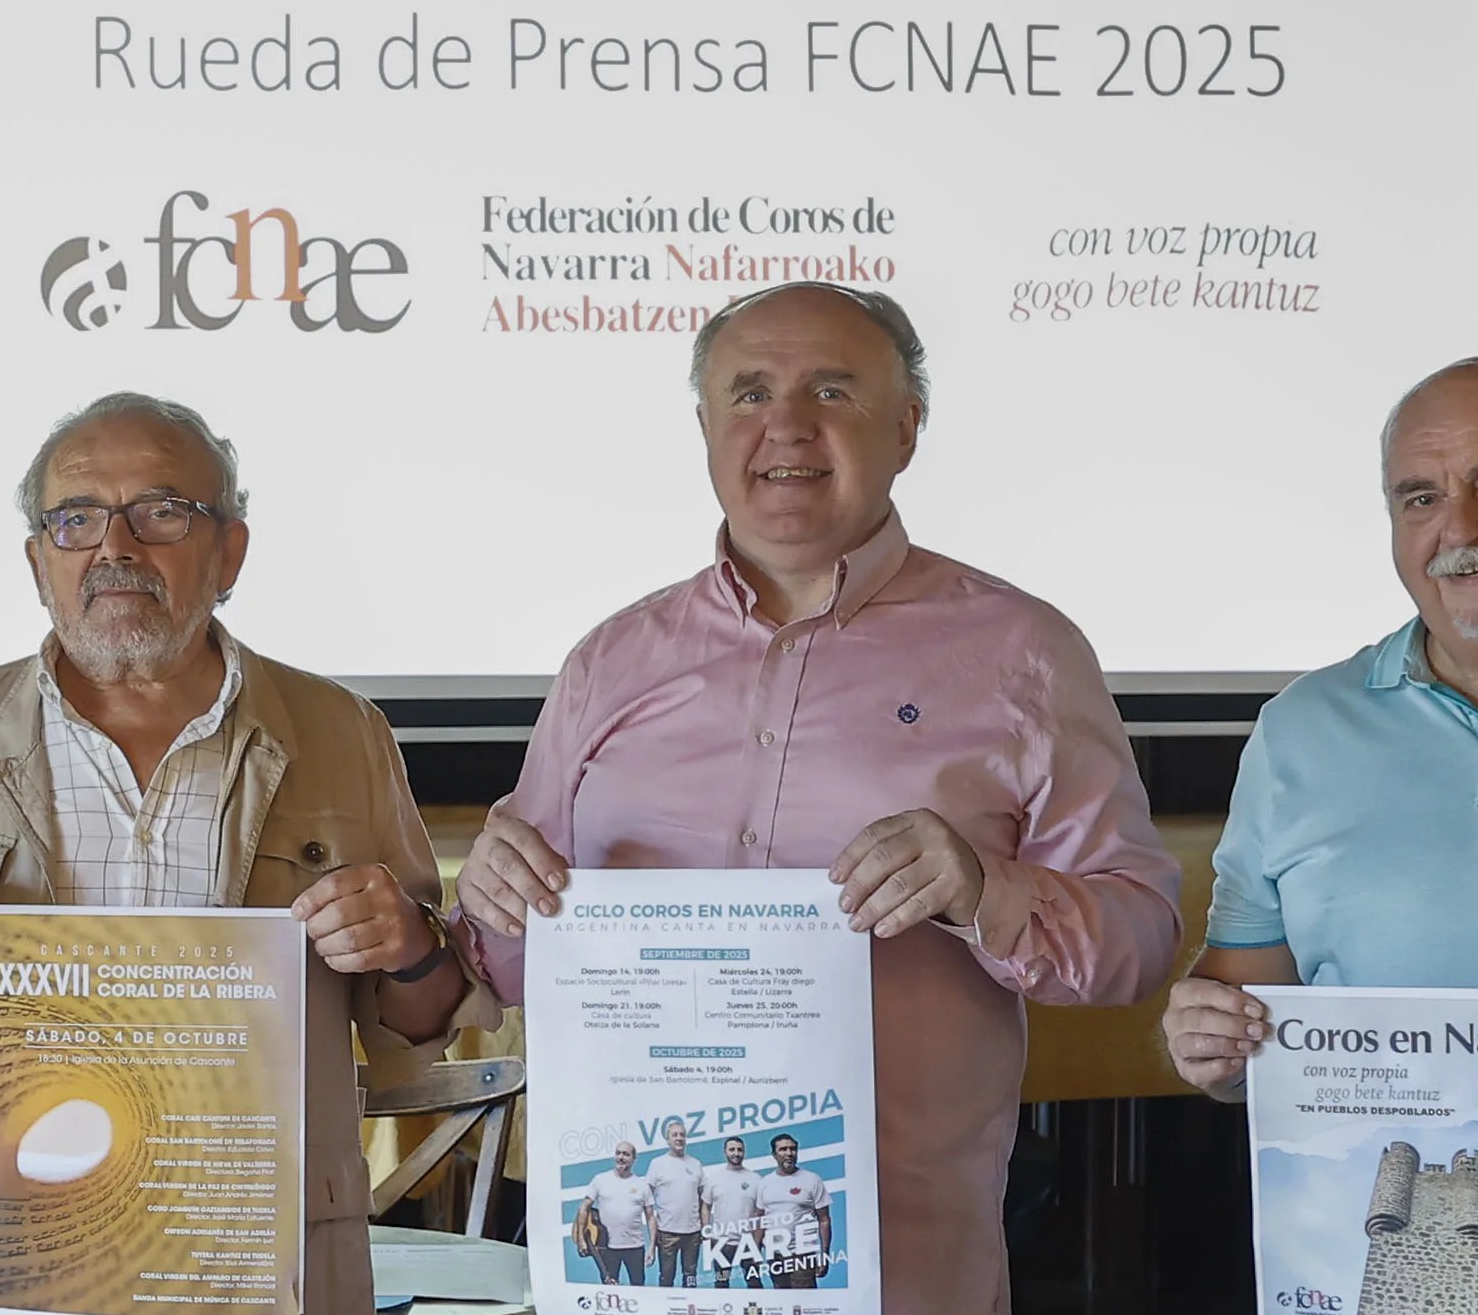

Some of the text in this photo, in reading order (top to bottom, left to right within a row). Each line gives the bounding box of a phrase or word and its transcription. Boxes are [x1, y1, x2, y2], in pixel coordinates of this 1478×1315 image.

[92, 13, 1287, 96] Rueda de Prensa FCNAE 2025
[481, 194, 895, 234] Federación de Coros de
[1049, 223, 1318, 269] con voz propia
[481, 243, 896, 283] Navarra Nafarroako
[1010, 271, 1320, 323] gogo bete kantuz
[481, 298, 711, 335] Abesbatzen
[574, 904, 819, 918] CICLO COROS EN NAVARRA
[728, 922, 747, 932] EN
[41, 945, 234, 958] CASCANTE 2025
[642, 950, 748, 958] SEPTIEMBRE DE 2025
[98, 963, 253, 980] CONCENTRACIÓN
[98, 983, 277, 999] CORAL DE LA RIBERA
[114, 1033, 123, 1043] 4
[133, 1033, 153, 1044] DE
[164, 1032, 247, 1045] OCTUBRE
[1277, 1019, 1379, 1053] Coros
[1390, 1030, 1431, 1053] en
[652, 1048, 743, 1057] OCTUBRE DE 2025
[1303, 1064, 1408, 1083] con voz propia
[1315, 1084, 1440, 1103] gogo bete kantuz
[718, 1089, 842, 1132] PROPIA
[1318, 1105, 1367, 1114] PUEBLOS
[701, 1212, 792, 1238] CUARTETO
[746, 1249, 848, 1280] ARGENTINA
